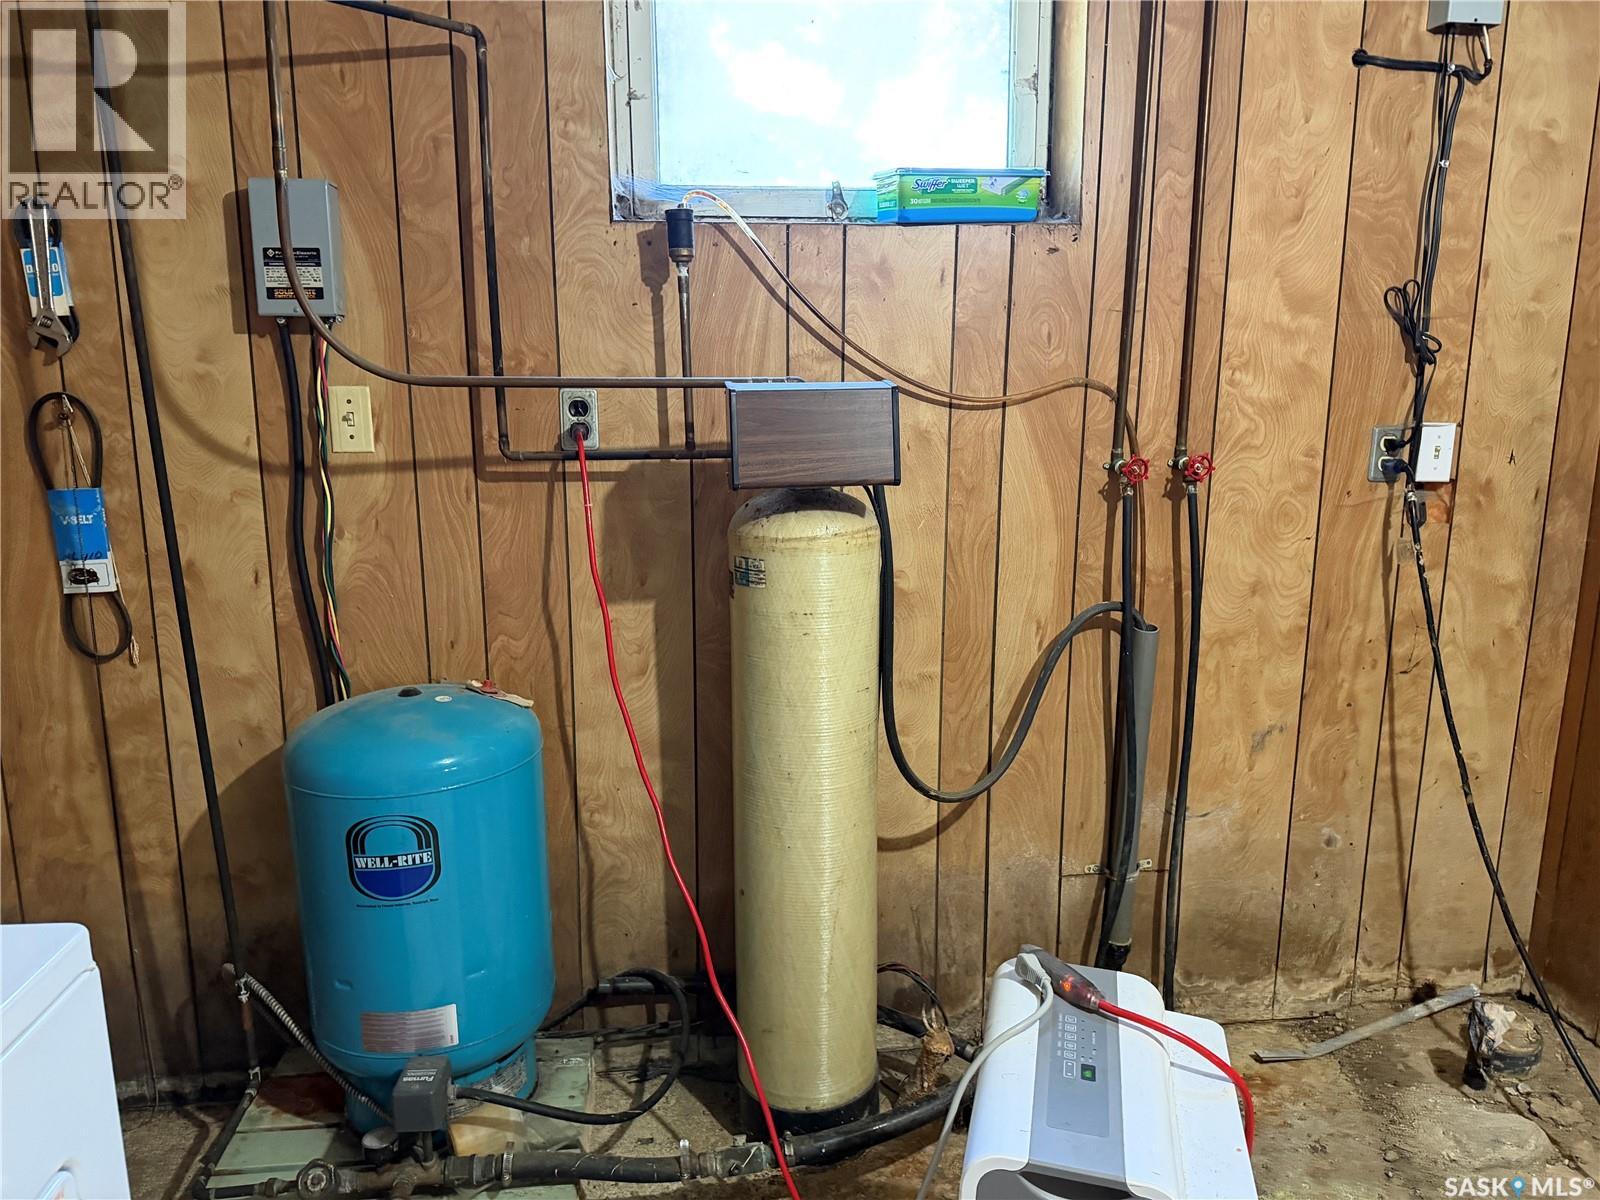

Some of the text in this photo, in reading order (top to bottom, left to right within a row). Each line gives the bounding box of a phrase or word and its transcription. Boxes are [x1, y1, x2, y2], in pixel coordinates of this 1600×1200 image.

[911, 177, 949, 192] Swiffer
[60, 514, 94, 525] V-BELT
[354, 851, 433, 869] WELL-RITE
